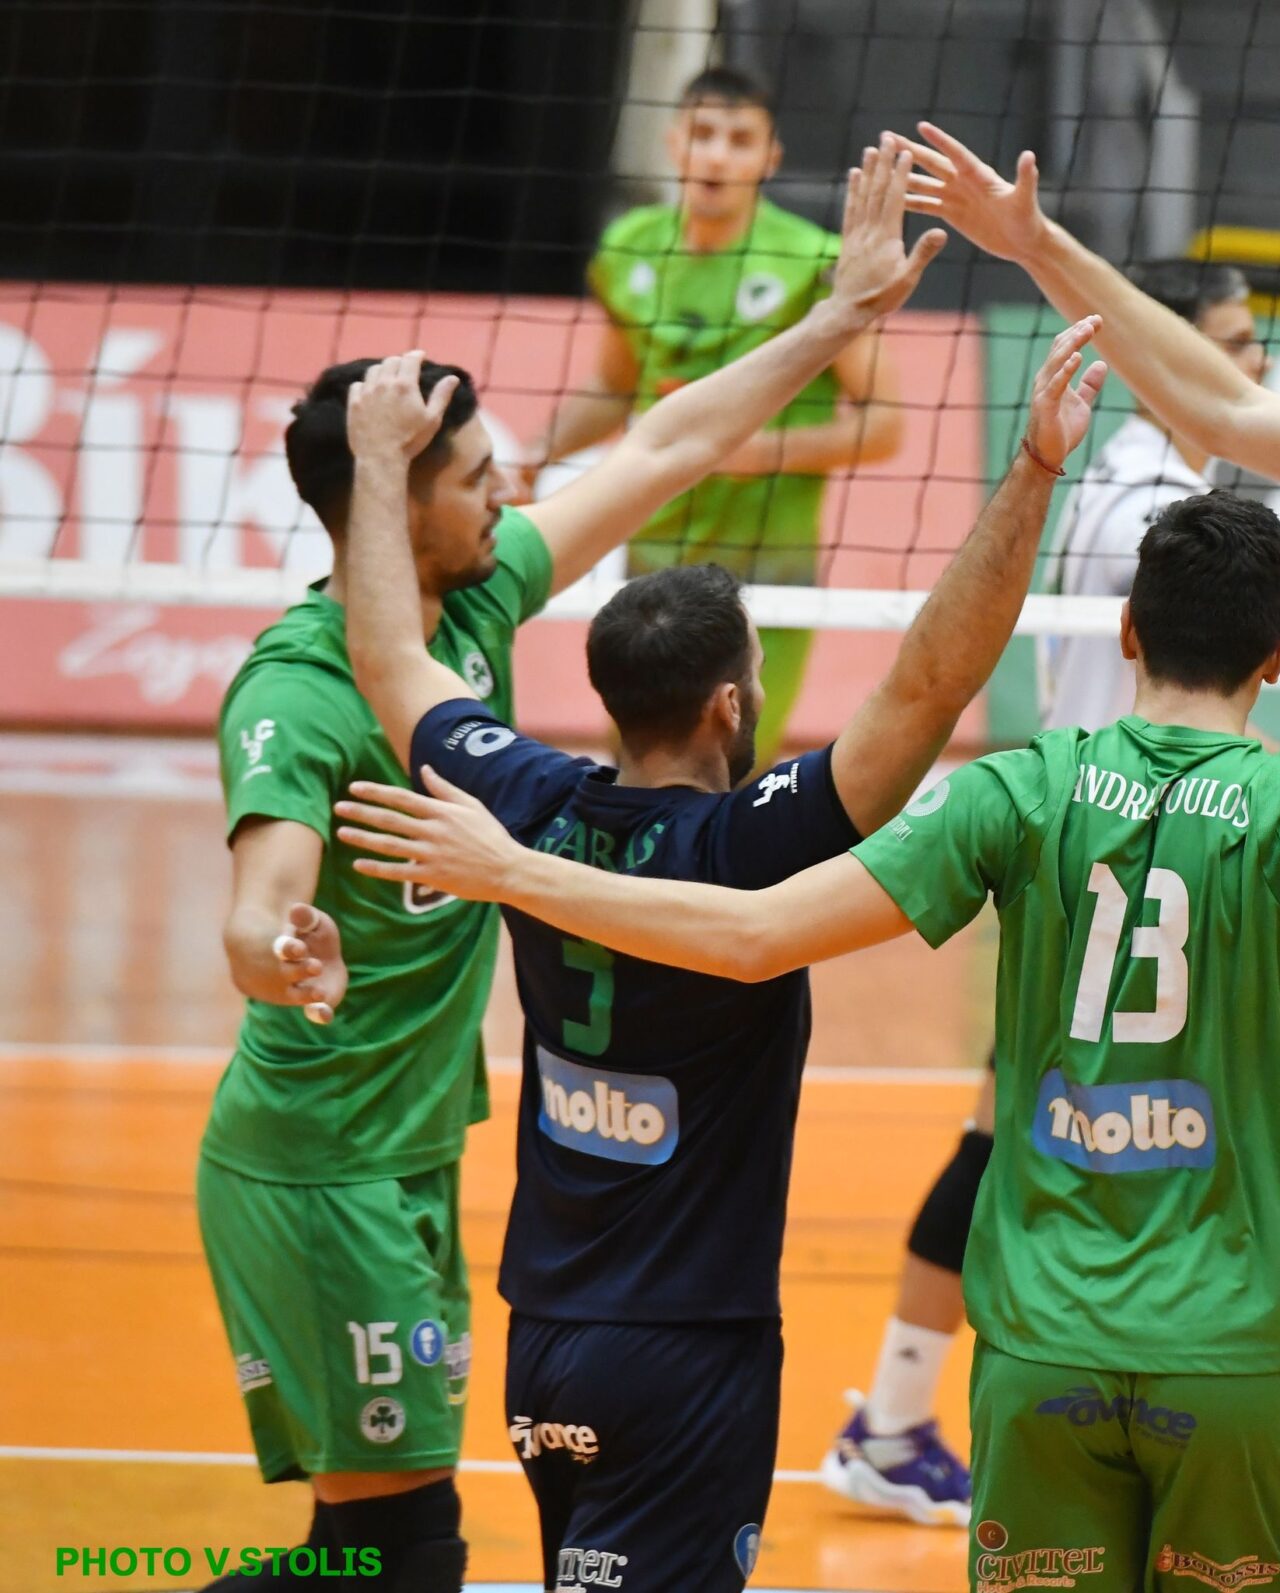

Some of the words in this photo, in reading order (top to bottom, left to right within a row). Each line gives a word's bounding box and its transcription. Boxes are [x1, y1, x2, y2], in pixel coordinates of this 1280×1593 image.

[1069, 862, 1190, 1043] 13
[541, 1075, 665, 1145] molto
[1049, 1094, 1207, 1155] molto
[347, 1321, 403, 1385] 15
